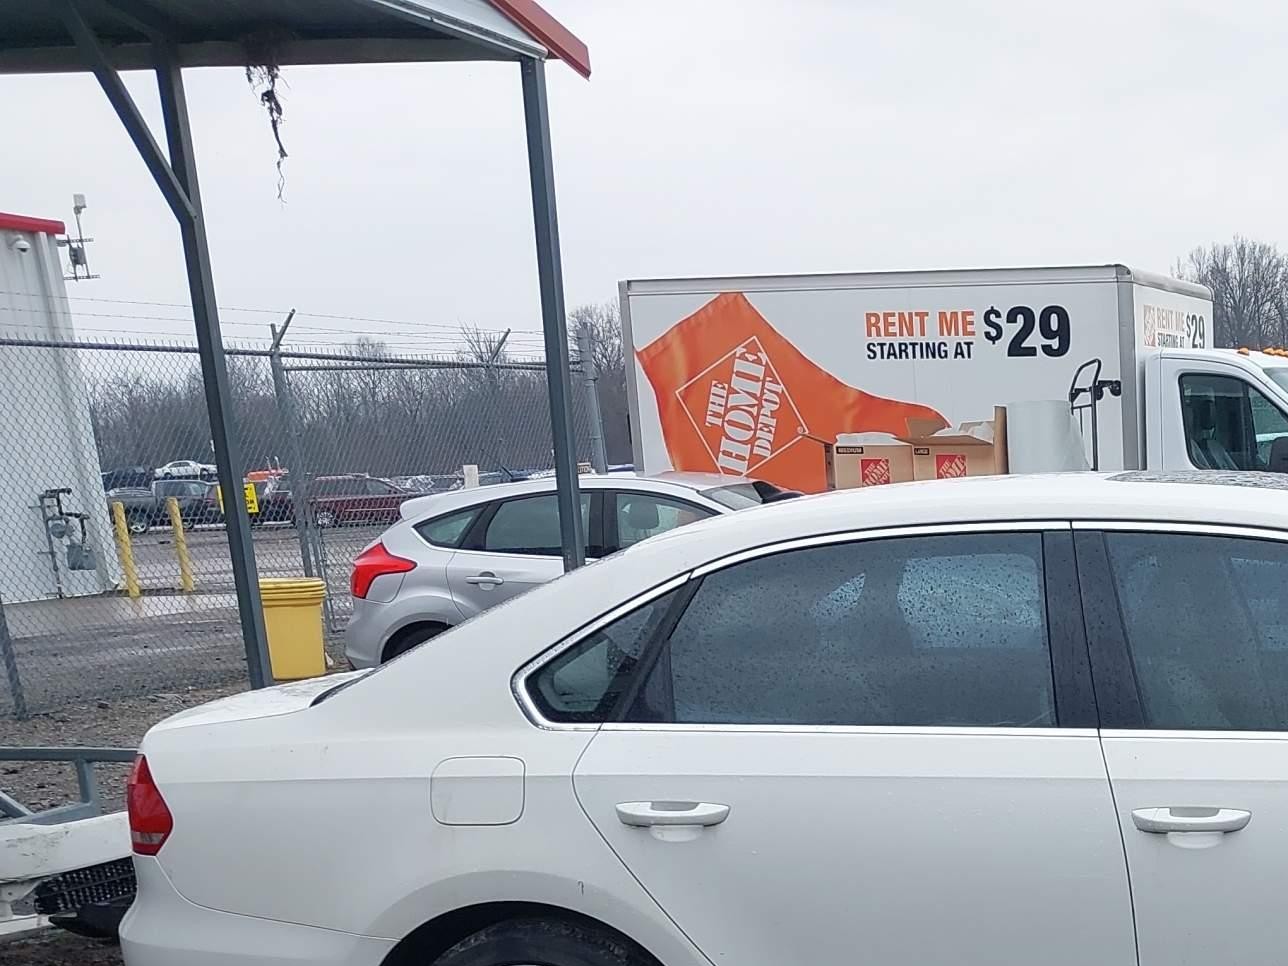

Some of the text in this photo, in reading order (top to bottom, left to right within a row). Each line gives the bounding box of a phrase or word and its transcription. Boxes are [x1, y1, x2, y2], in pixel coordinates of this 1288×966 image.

[865, 305, 1071, 357] RENT ME $29
[866, 341, 974, 359] STARTING AT
[1186, 312, 1205, 349] $29
[705, 380, 729, 428] THE
[718, 347, 768, 474] HOME
[753, 376, 784, 458] DEPOT
